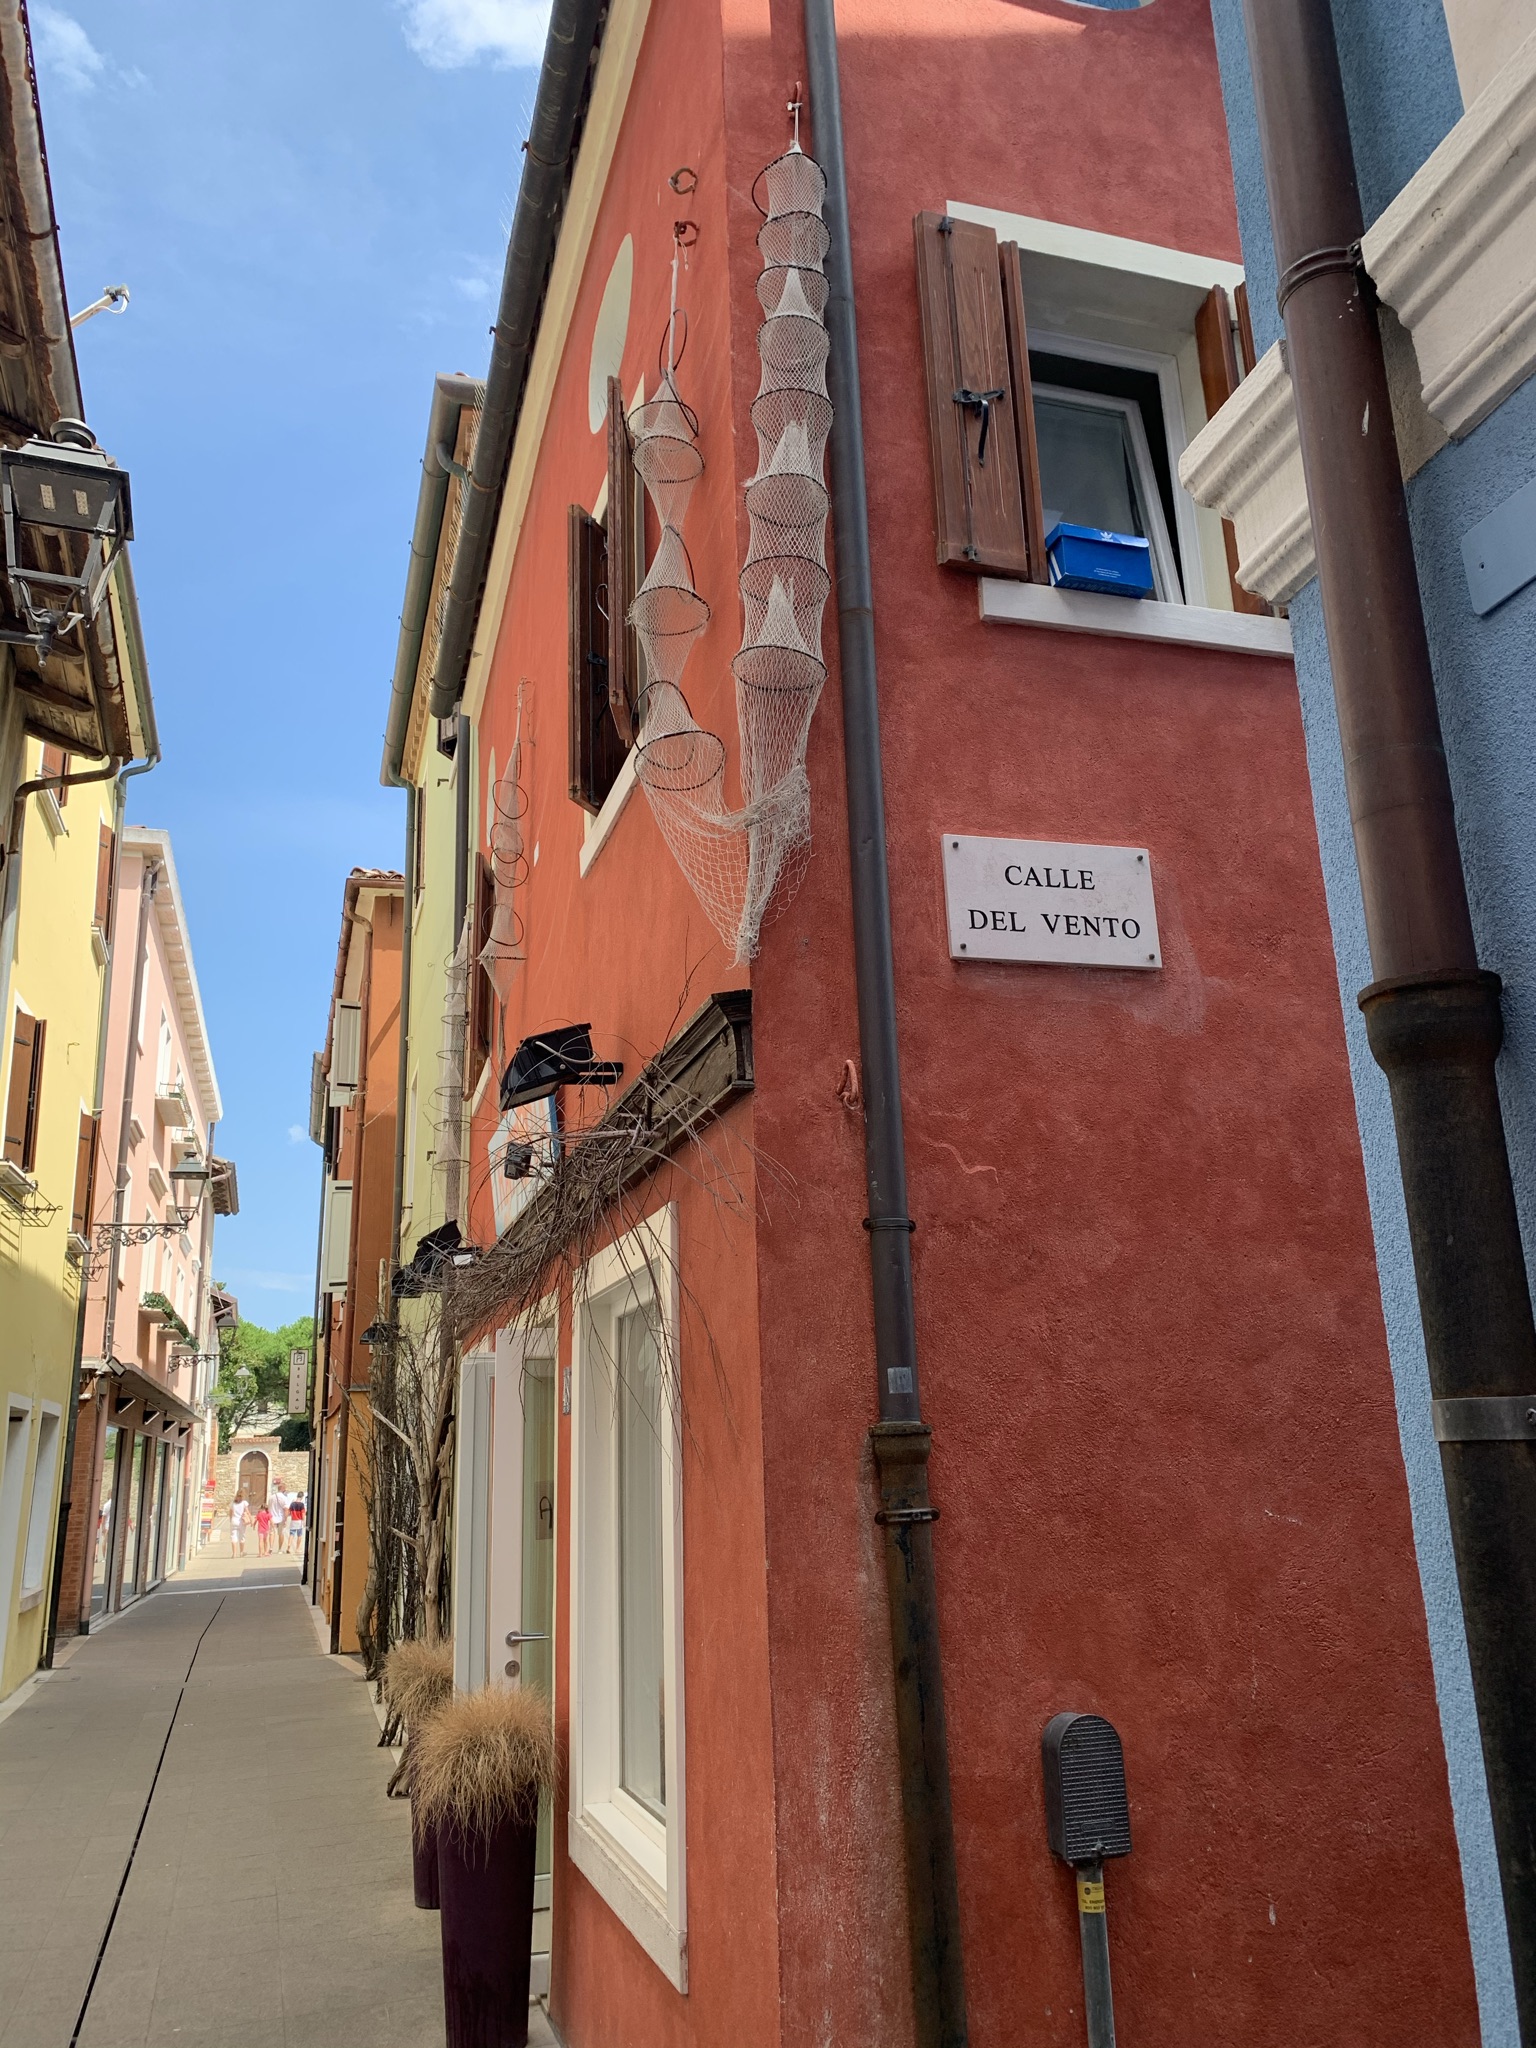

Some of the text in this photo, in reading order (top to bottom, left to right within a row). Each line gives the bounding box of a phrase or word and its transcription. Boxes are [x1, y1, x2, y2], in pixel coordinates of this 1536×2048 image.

[1004, 865, 1096, 890] CALLE
[967, 909, 1141, 939] DEL VENTO
